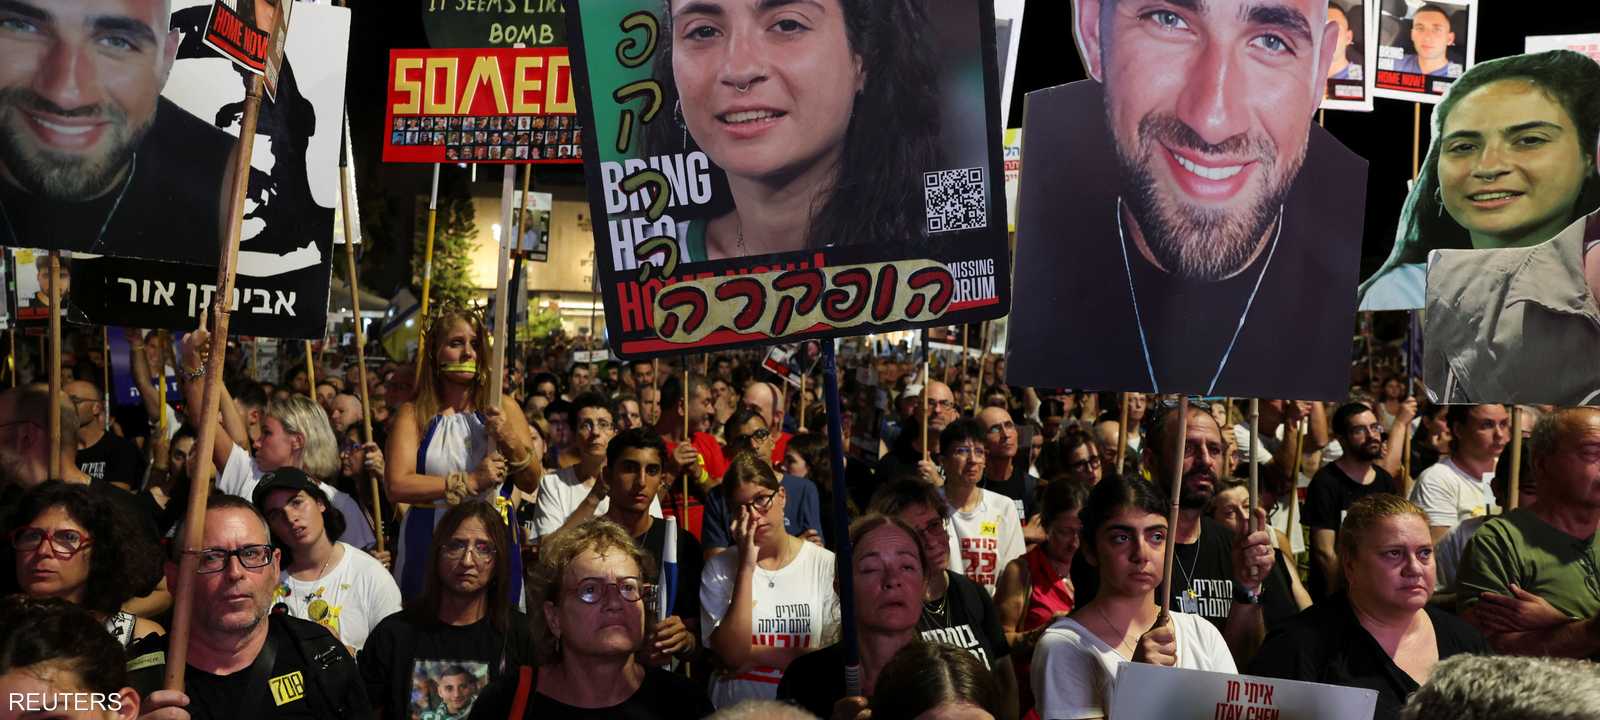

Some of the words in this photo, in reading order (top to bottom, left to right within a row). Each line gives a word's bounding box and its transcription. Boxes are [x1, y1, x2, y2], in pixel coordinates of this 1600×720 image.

[428, 0, 447, 12] IT
[455, 0, 516, 14] SEEMS
[523, 0, 566, 14] LIK
[213, 5, 242, 46] HOME
[488, 22, 554, 45] BOMB
[393, 56, 577, 115] SOMEO
[948, 258, 995, 279] MISSING
[117, 277, 176, 307] אור
[658, 263, 955, 338] הופקרה
[952, 276, 996, 304] ORUM
[775, 603, 811, 618] מחזירים
[758, 618, 788, 634] הביתה
[789, 618, 812, 634] אותם
[1226, 680, 1241, 703] חן
[1244, 682, 1275, 706] איתי
[1214, 702, 1244, 720] ITAY
[1246, 705, 1280, 720] CHEN
